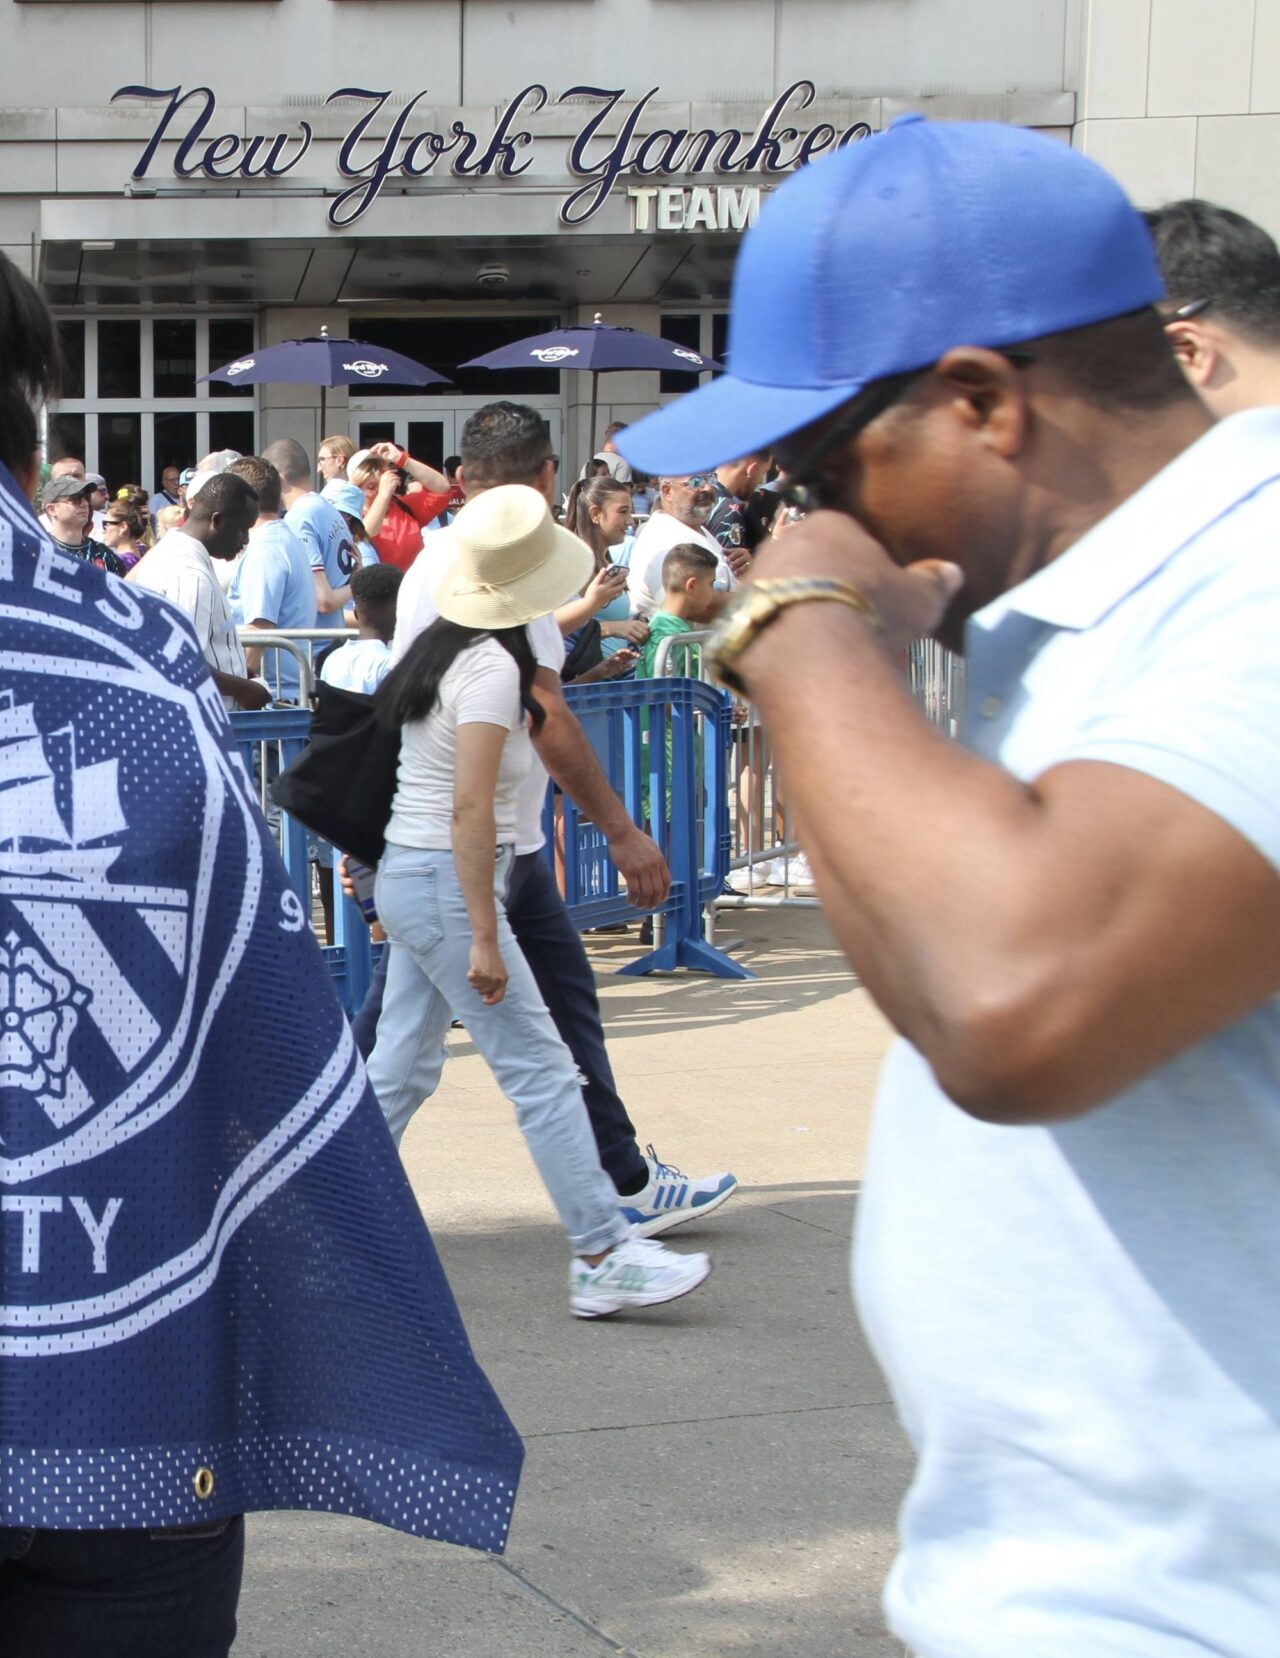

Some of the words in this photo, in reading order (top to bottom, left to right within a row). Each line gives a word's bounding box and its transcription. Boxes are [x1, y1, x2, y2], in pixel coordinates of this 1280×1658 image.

[110, 85, 312, 181] New
[323, 84, 549, 229] York
[558, 80, 872, 227] Yanke
[628, 186, 760, 230] TEAM
[278, 889, 313, 934] 9
